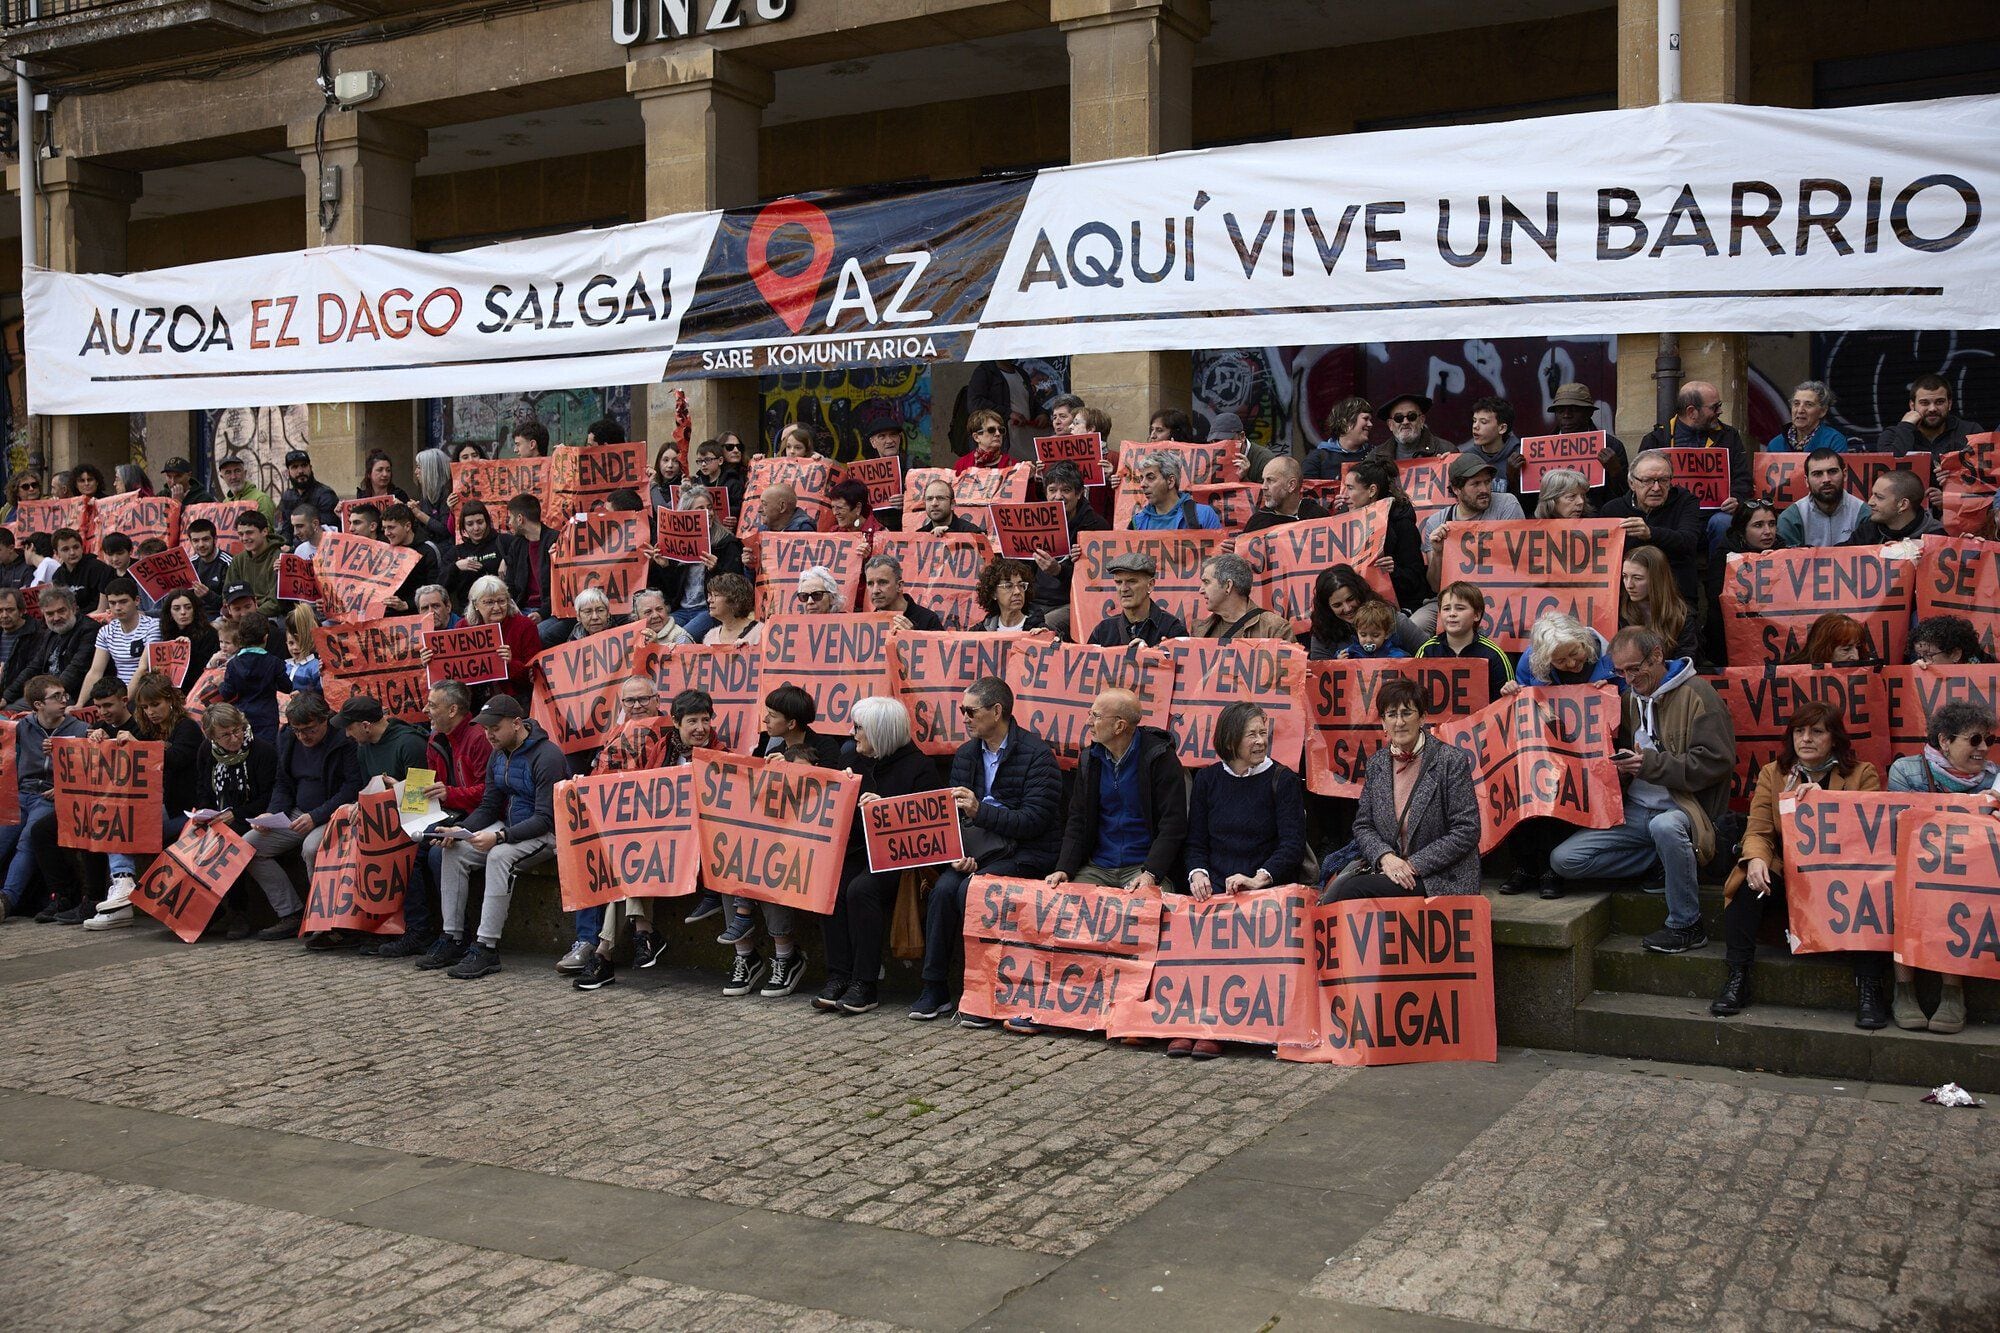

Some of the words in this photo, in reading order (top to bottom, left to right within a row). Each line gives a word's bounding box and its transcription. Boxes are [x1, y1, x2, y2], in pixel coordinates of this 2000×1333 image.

[1017, 190, 1211, 293] AQUÍ
[1223, 201, 1406, 281] VIVE
[1436, 191, 1558, 269] UN
[1596, 174, 1982, 260] BARRIO
[826, 250, 933, 327] AZ
[79, 303, 234, 358] AUZOA
[250, 295, 300, 350] EZ
[318, 286, 463, 344] DAGO
[476, 267, 672, 335] SALGAI
[702, 349, 754, 372] SARE
[767, 337, 938, 366] KOMUNITARIOA
[1040, 441, 1054, 459] SE
[1056, 439, 1094, 456] VENDE
[1530, 441, 1546, 458] SE
[1551, 436, 1598, 456] VENDE
[1677, 452, 1723, 473] VENDE
[1960, 443, 1995, 485] SE
[460, 469, 482, 498] SE
[485, 465, 543, 497] VENDE
[859, 462, 894, 481] VENDE
[1763, 462, 1795, 502] SE
[18, 508, 35, 533] SE
[571, 519, 637, 557] ENDE
[669, 514, 701, 532] VENDE
[999, 508, 1013, 527] SE
[1014, 506, 1059, 529] VENDE
[137, 562, 153, 579] SE
[149, 551, 185, 571] VENDE
[286, 558, 298, 573] SE
[341, 541, 407, 580] VENDE
[664, 538, 699, 557] SALGAI
[776, 540, 849, 574] VENDE
[1087, 540, 1116, 580] SE
[1248, 537, 1279, 575] SE
[1459, 531, 1494, 575] SE
[1504, 529, 1609, 574] VENDE
[1736, 559, 1774, 604] SE
[1786, 555, 1904, 601] VENDE
[1934, 547, 1981, 597] SE
[155, 646, 167, 662] SE
[326, 632, 351, 669] SE
[356, 624, 422, 663] VENDE
[432, 636, 446, 654] SE
[448, 630, 494, 651] VENDE
[562, 632, 636, 685] VENDE
[766, 624, 796, 663] SE
[809, 622, 890, 662] VENDE
[897, 640, 927, 681] SE
[941, 640, 1010, 681] VEN
[444, 658, 492, 681] SALGAI
[679, 653, 761, 693] VENDE
[1020, 646, 1055, 690] SE
[1066, 652, 1158, 702] VENDE
[1199, 648, 1292, 695] VENDE
[1317, 670, 1347, 717] SE
[1455, 721, 1489, 773] SE
[1498, 695, 1603, 749] VENDE
[59, 746, 75, 784] SE
[80, 748, 148, 788] VENDE
[566, 786, 590, 833] SE
[598, 774, 692, 824] VENDE
[701, 761, 738, 810] SE
[747, 767, 842, 828] VENDE
[872, 804, 891, 828] SE
[894, 796, 949, 823] VENDE
[1490, 758, 1589, 828] SALGAI
[888, 831, 946, 861] SALGAI
[1796, 802, 1842, 856] SE
[1917, 823, 1970, 876] SE
[587, 839, 676, 894] SALGAI
[711, 831, 815, 895] SALGAI
[981, 883, 1018, 932] SE
[1031, 891, 1140, 945] VENDE
[1188, 897, 1305, 950] VENDE
[1316, 914, 1339, 971] SE
[1345, 909, 1475, 966] VENDE
[998, 954, 1121, 1017] SALGAI
[1151, 974, 1286, 1028] SALGAI
[1329, 989, 1460, 1049] SALGAI
